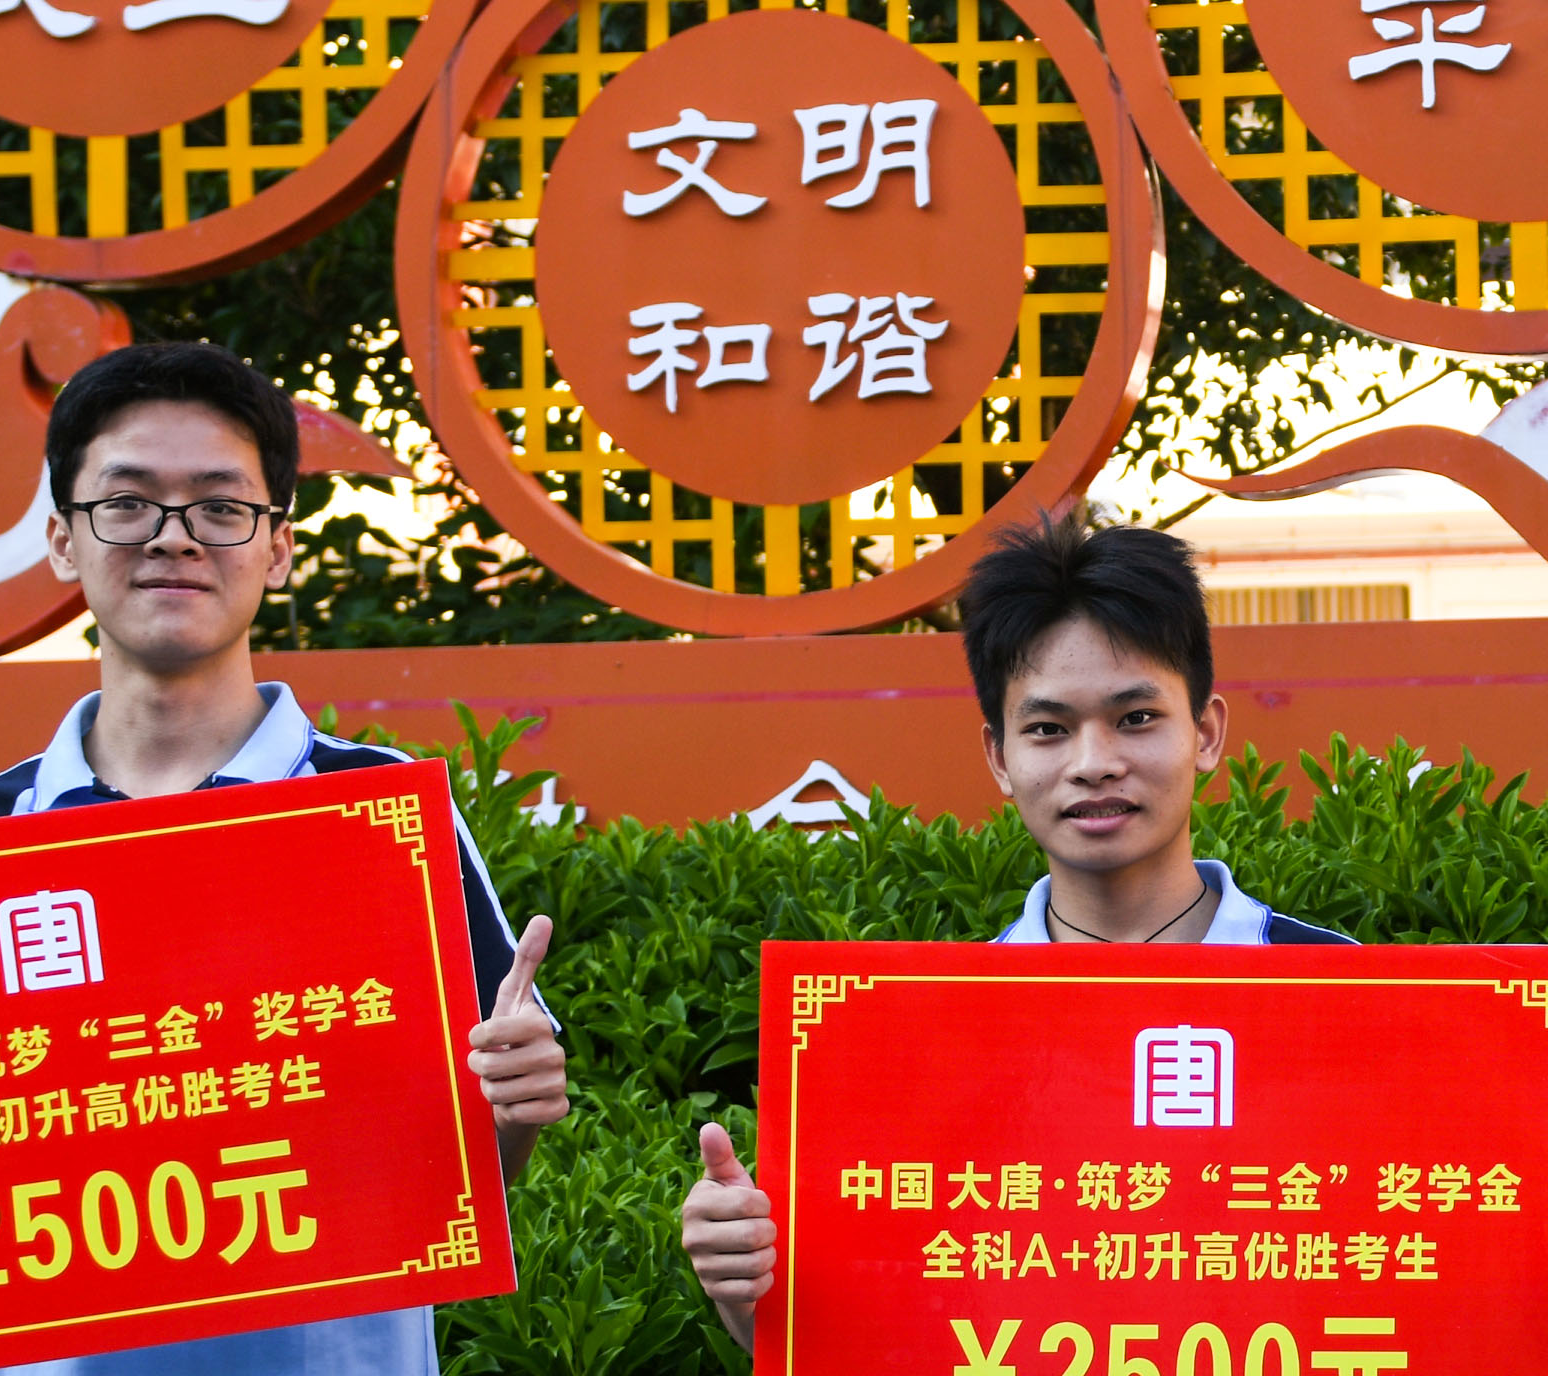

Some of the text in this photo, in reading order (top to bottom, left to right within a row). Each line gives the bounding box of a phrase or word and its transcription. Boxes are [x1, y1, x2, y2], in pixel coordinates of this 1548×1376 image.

[622, 98, 938, 217] 文明
[627, 291, 949, 413] 和谐
[1133, 1024, 1234, 1127] 唐
[922, 1231, 1439, 1281] 全科A+初升高优胜考生
